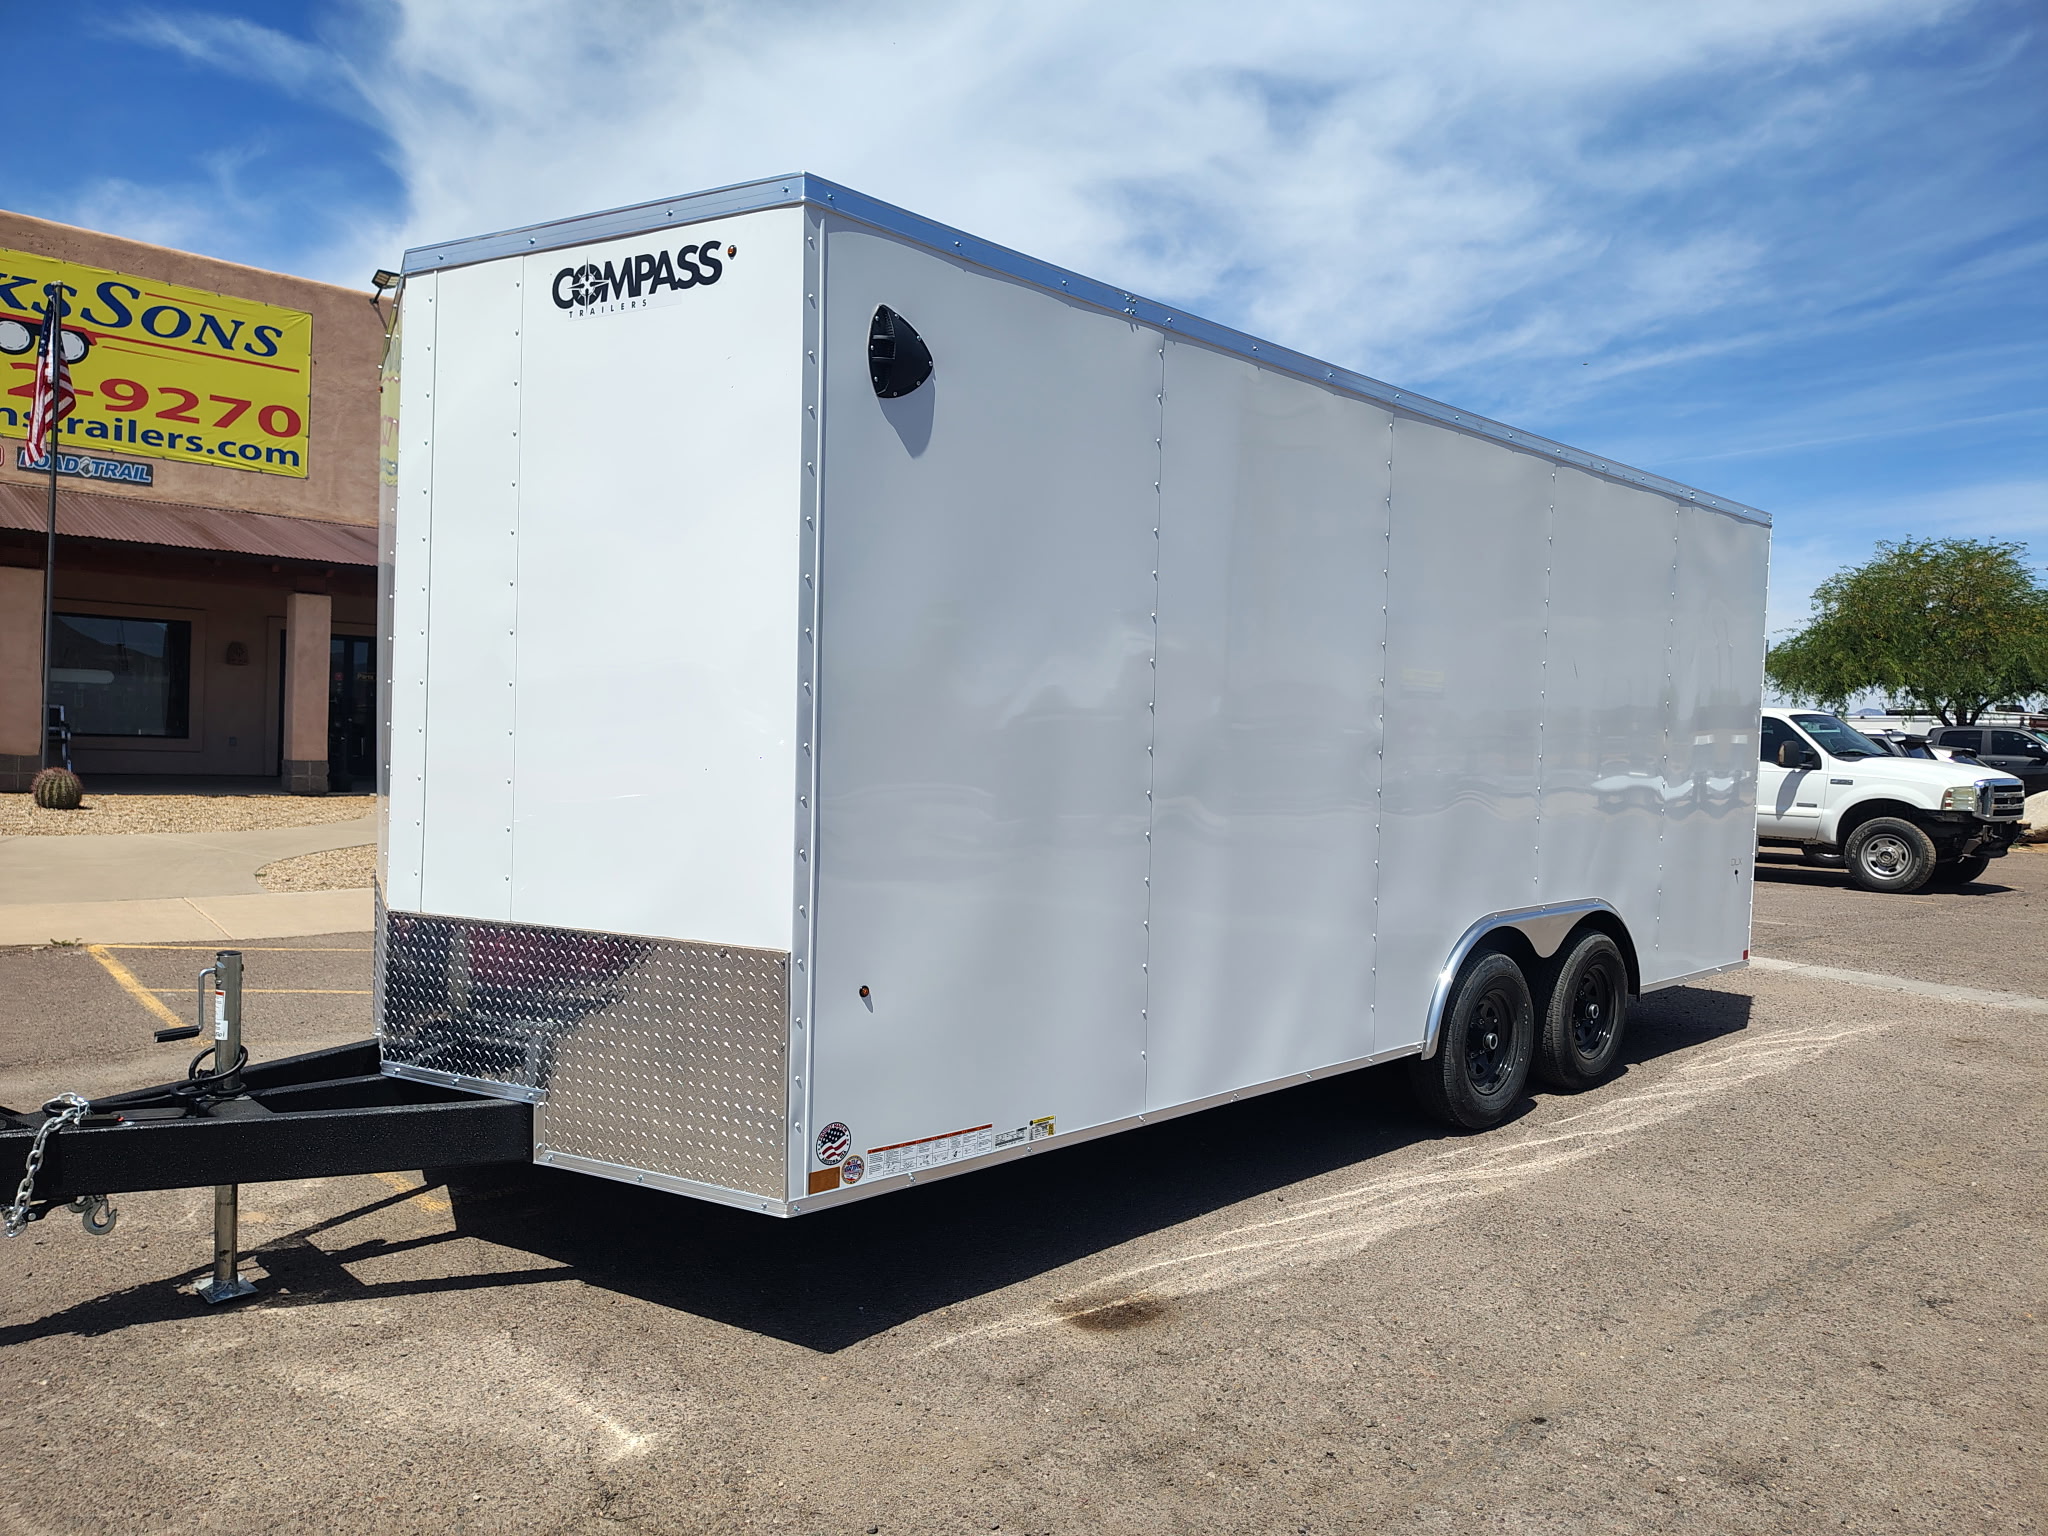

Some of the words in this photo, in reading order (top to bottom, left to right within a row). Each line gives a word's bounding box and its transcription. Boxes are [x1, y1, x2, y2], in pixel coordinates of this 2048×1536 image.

[552, 240, 723, 309] COMPASS
[569, 298, 647, 319] TRAILERS
[0, 406, 299, 467] nrailers.com
[88, 459, 152, 483] TRAIL
